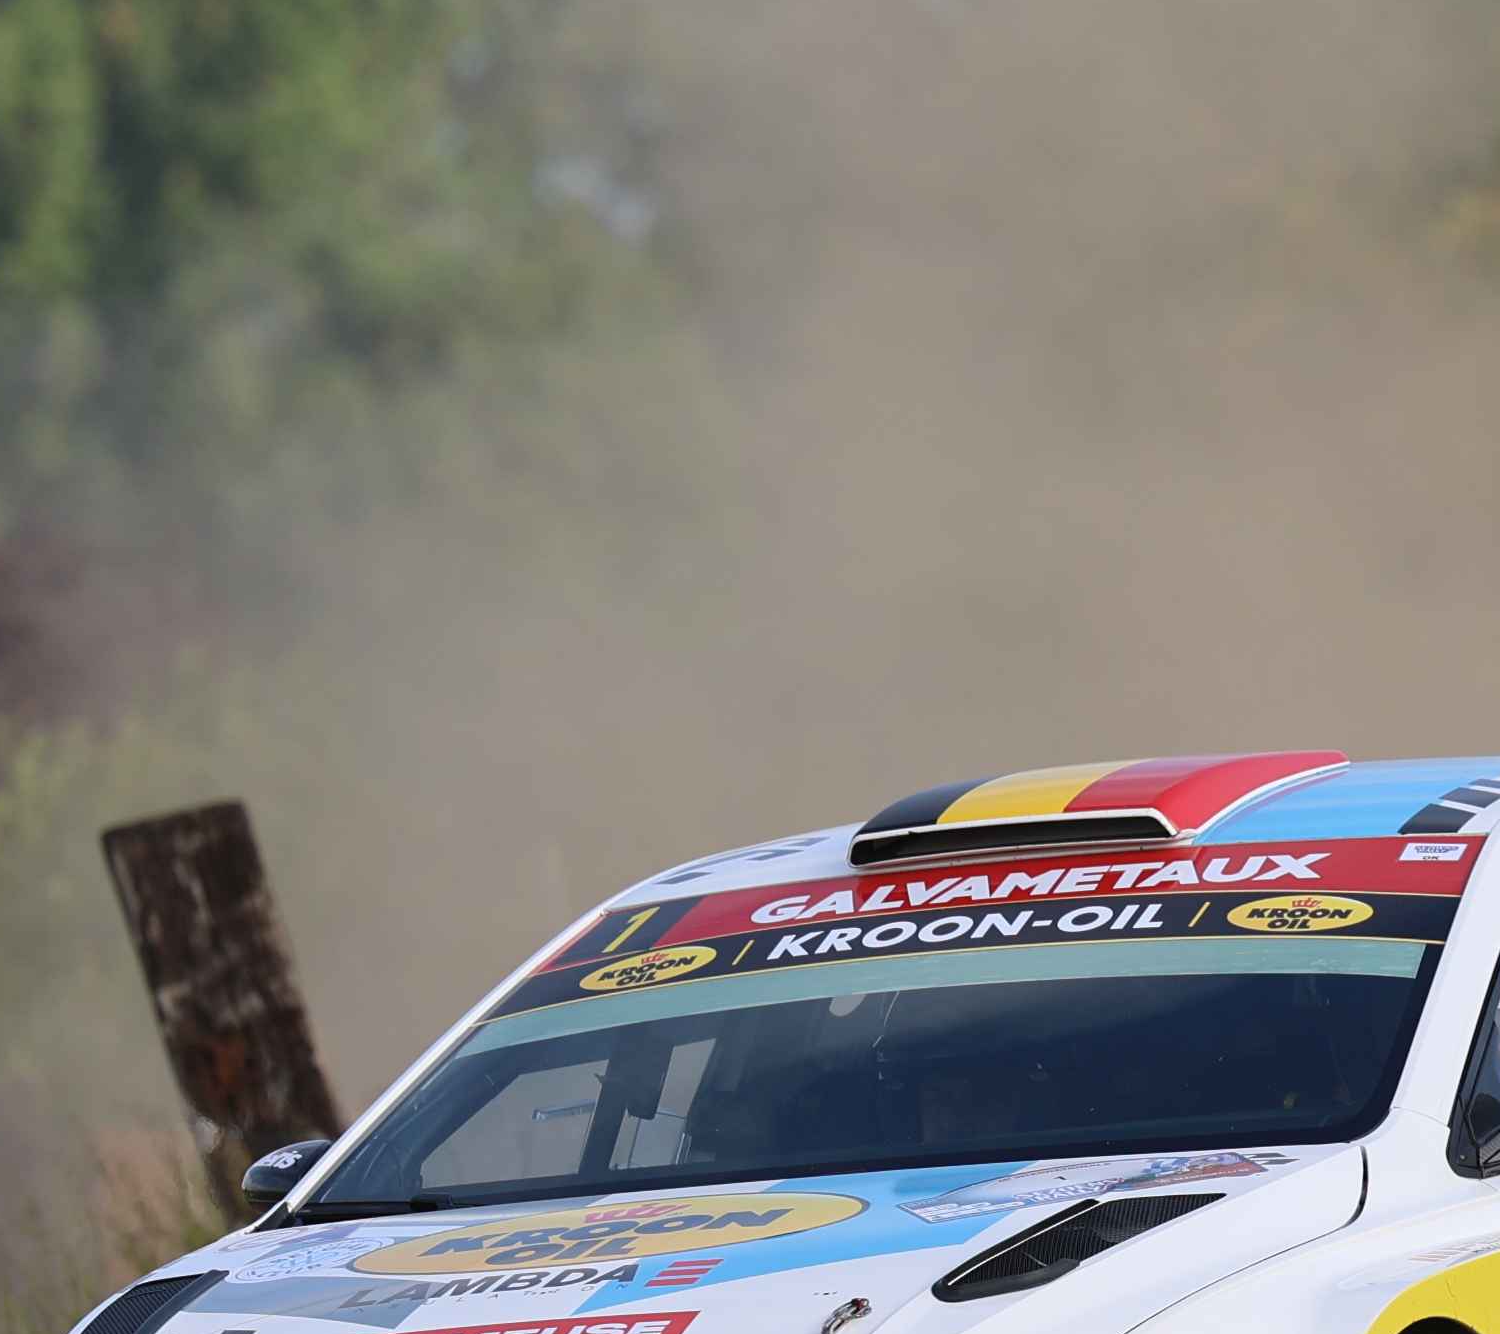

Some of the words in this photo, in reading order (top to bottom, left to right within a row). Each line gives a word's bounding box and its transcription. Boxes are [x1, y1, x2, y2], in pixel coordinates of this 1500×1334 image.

[750, 852, 1332, 924] GALVAMETAUX
[603, 907, 660, 953] 1
[1246, 907, 1353, 919] KROON
[1267, 918, 1311, 929] OIL
[766, 903, 1163, 961] KROON-OIL
[597, 955, 697, 981] KROON
[616, 971, 658, 986] OIL
[418, 1208, 795, 1257] KROON
[484, 1236, 639, 1265] OIL
[338, 1264, 641, 1308] LAMBDA
